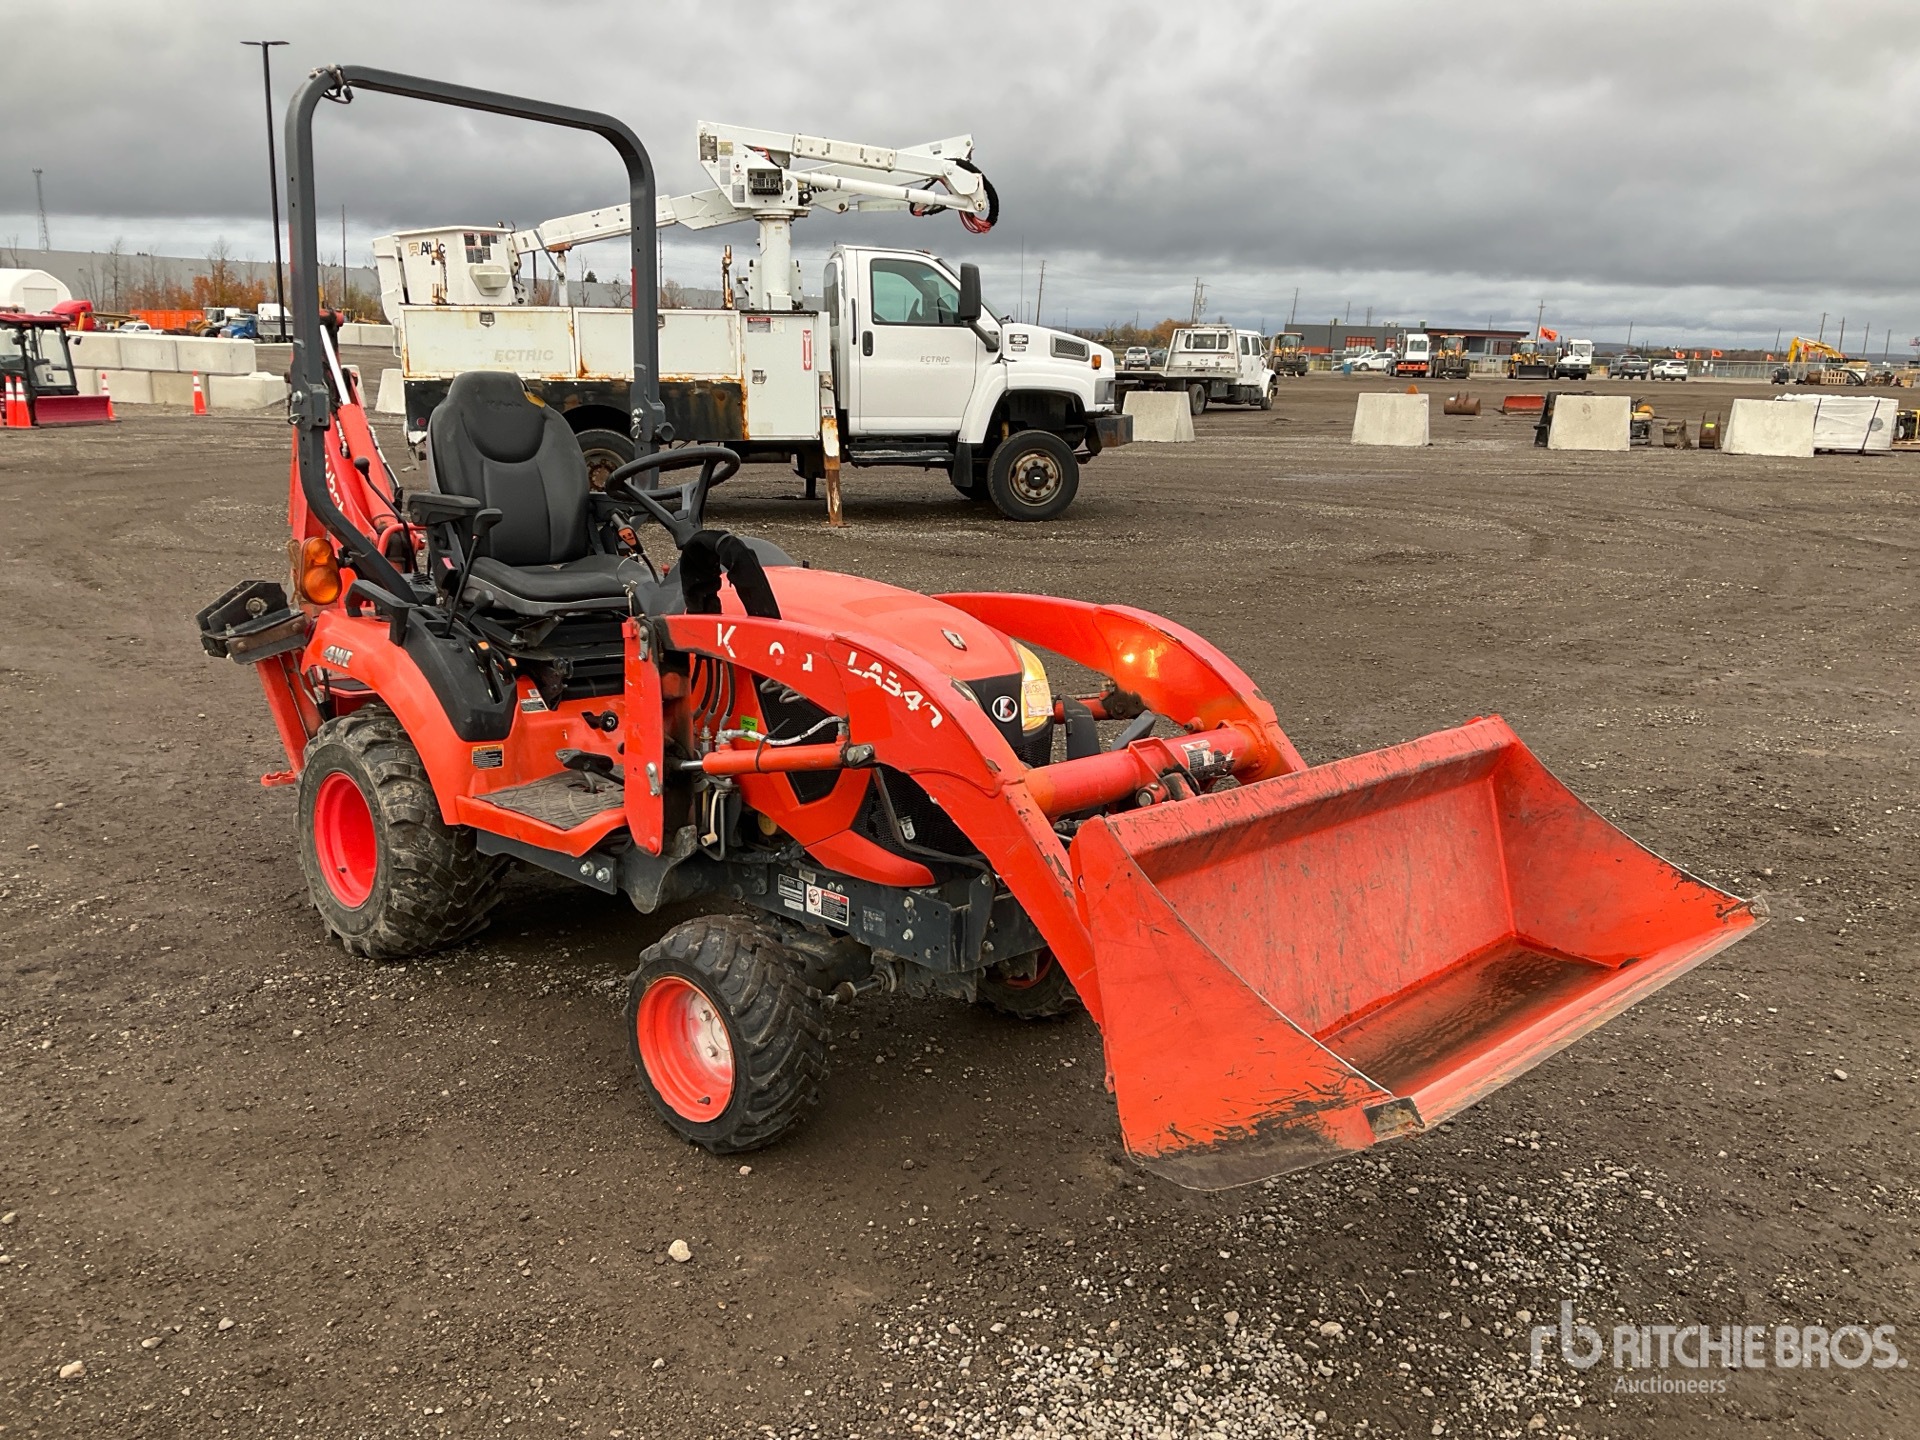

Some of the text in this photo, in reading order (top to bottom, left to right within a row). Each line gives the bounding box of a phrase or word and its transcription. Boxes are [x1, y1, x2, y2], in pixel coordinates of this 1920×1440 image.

[420, 241, 446, 256] Altc
[494, 349, 554, 361] ECTRIC
[920, 355, 951, 363] ECTRIC
